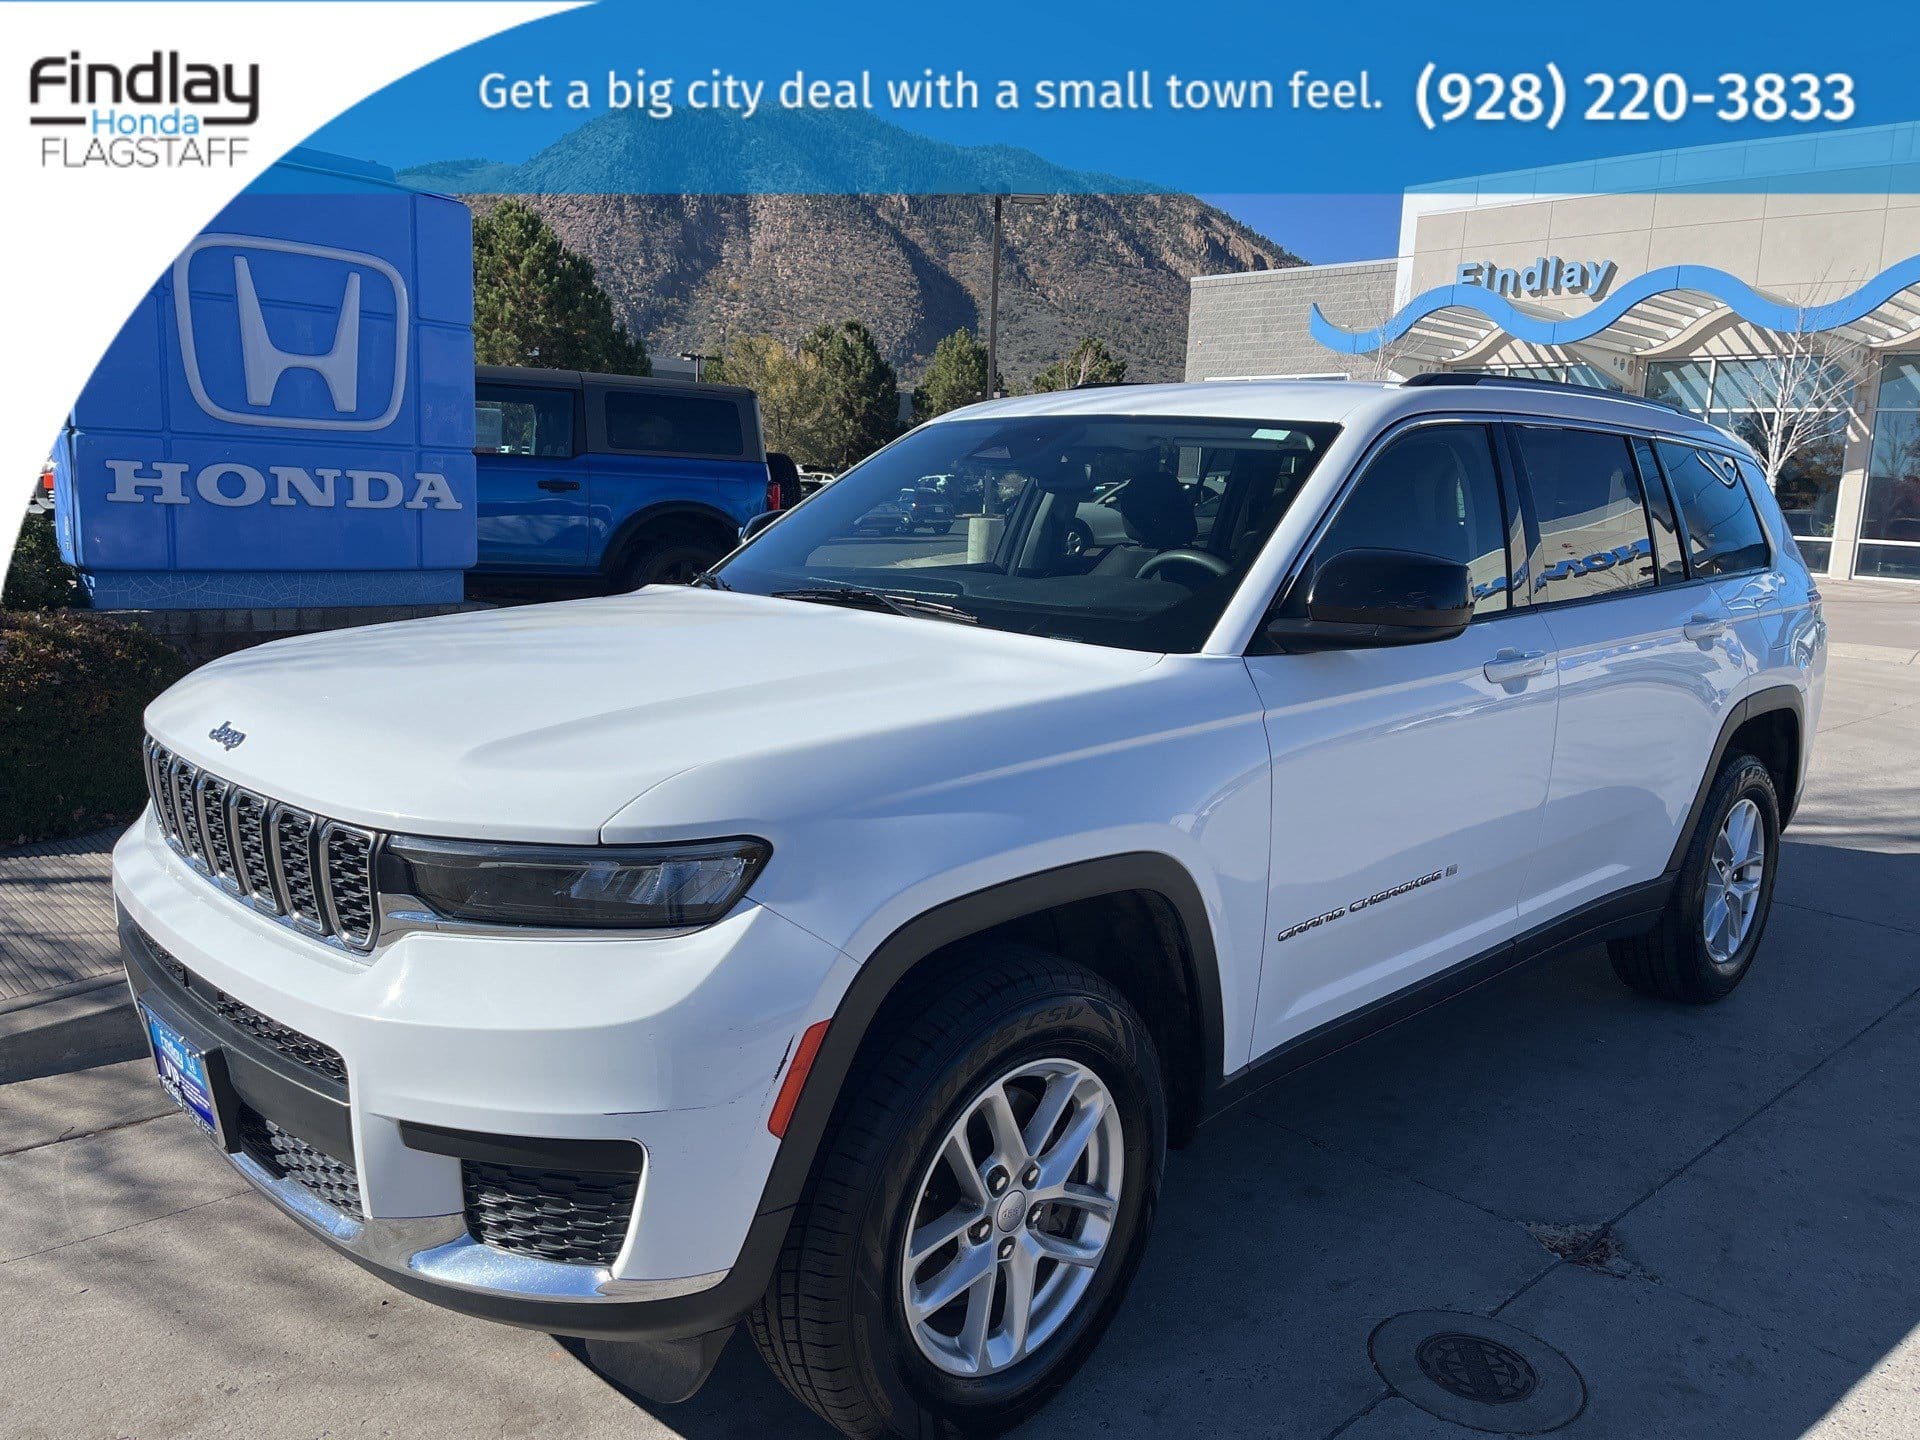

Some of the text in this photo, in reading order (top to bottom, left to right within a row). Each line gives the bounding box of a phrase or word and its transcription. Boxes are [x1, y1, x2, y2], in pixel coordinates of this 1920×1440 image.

[1456, 255, 1613, 297] Findlay
[105, 459, 463, 511] HONDA
[1278, 906, 1346, 942] GRAND
[1349, 869, 1443, 913] CHEROKEE
